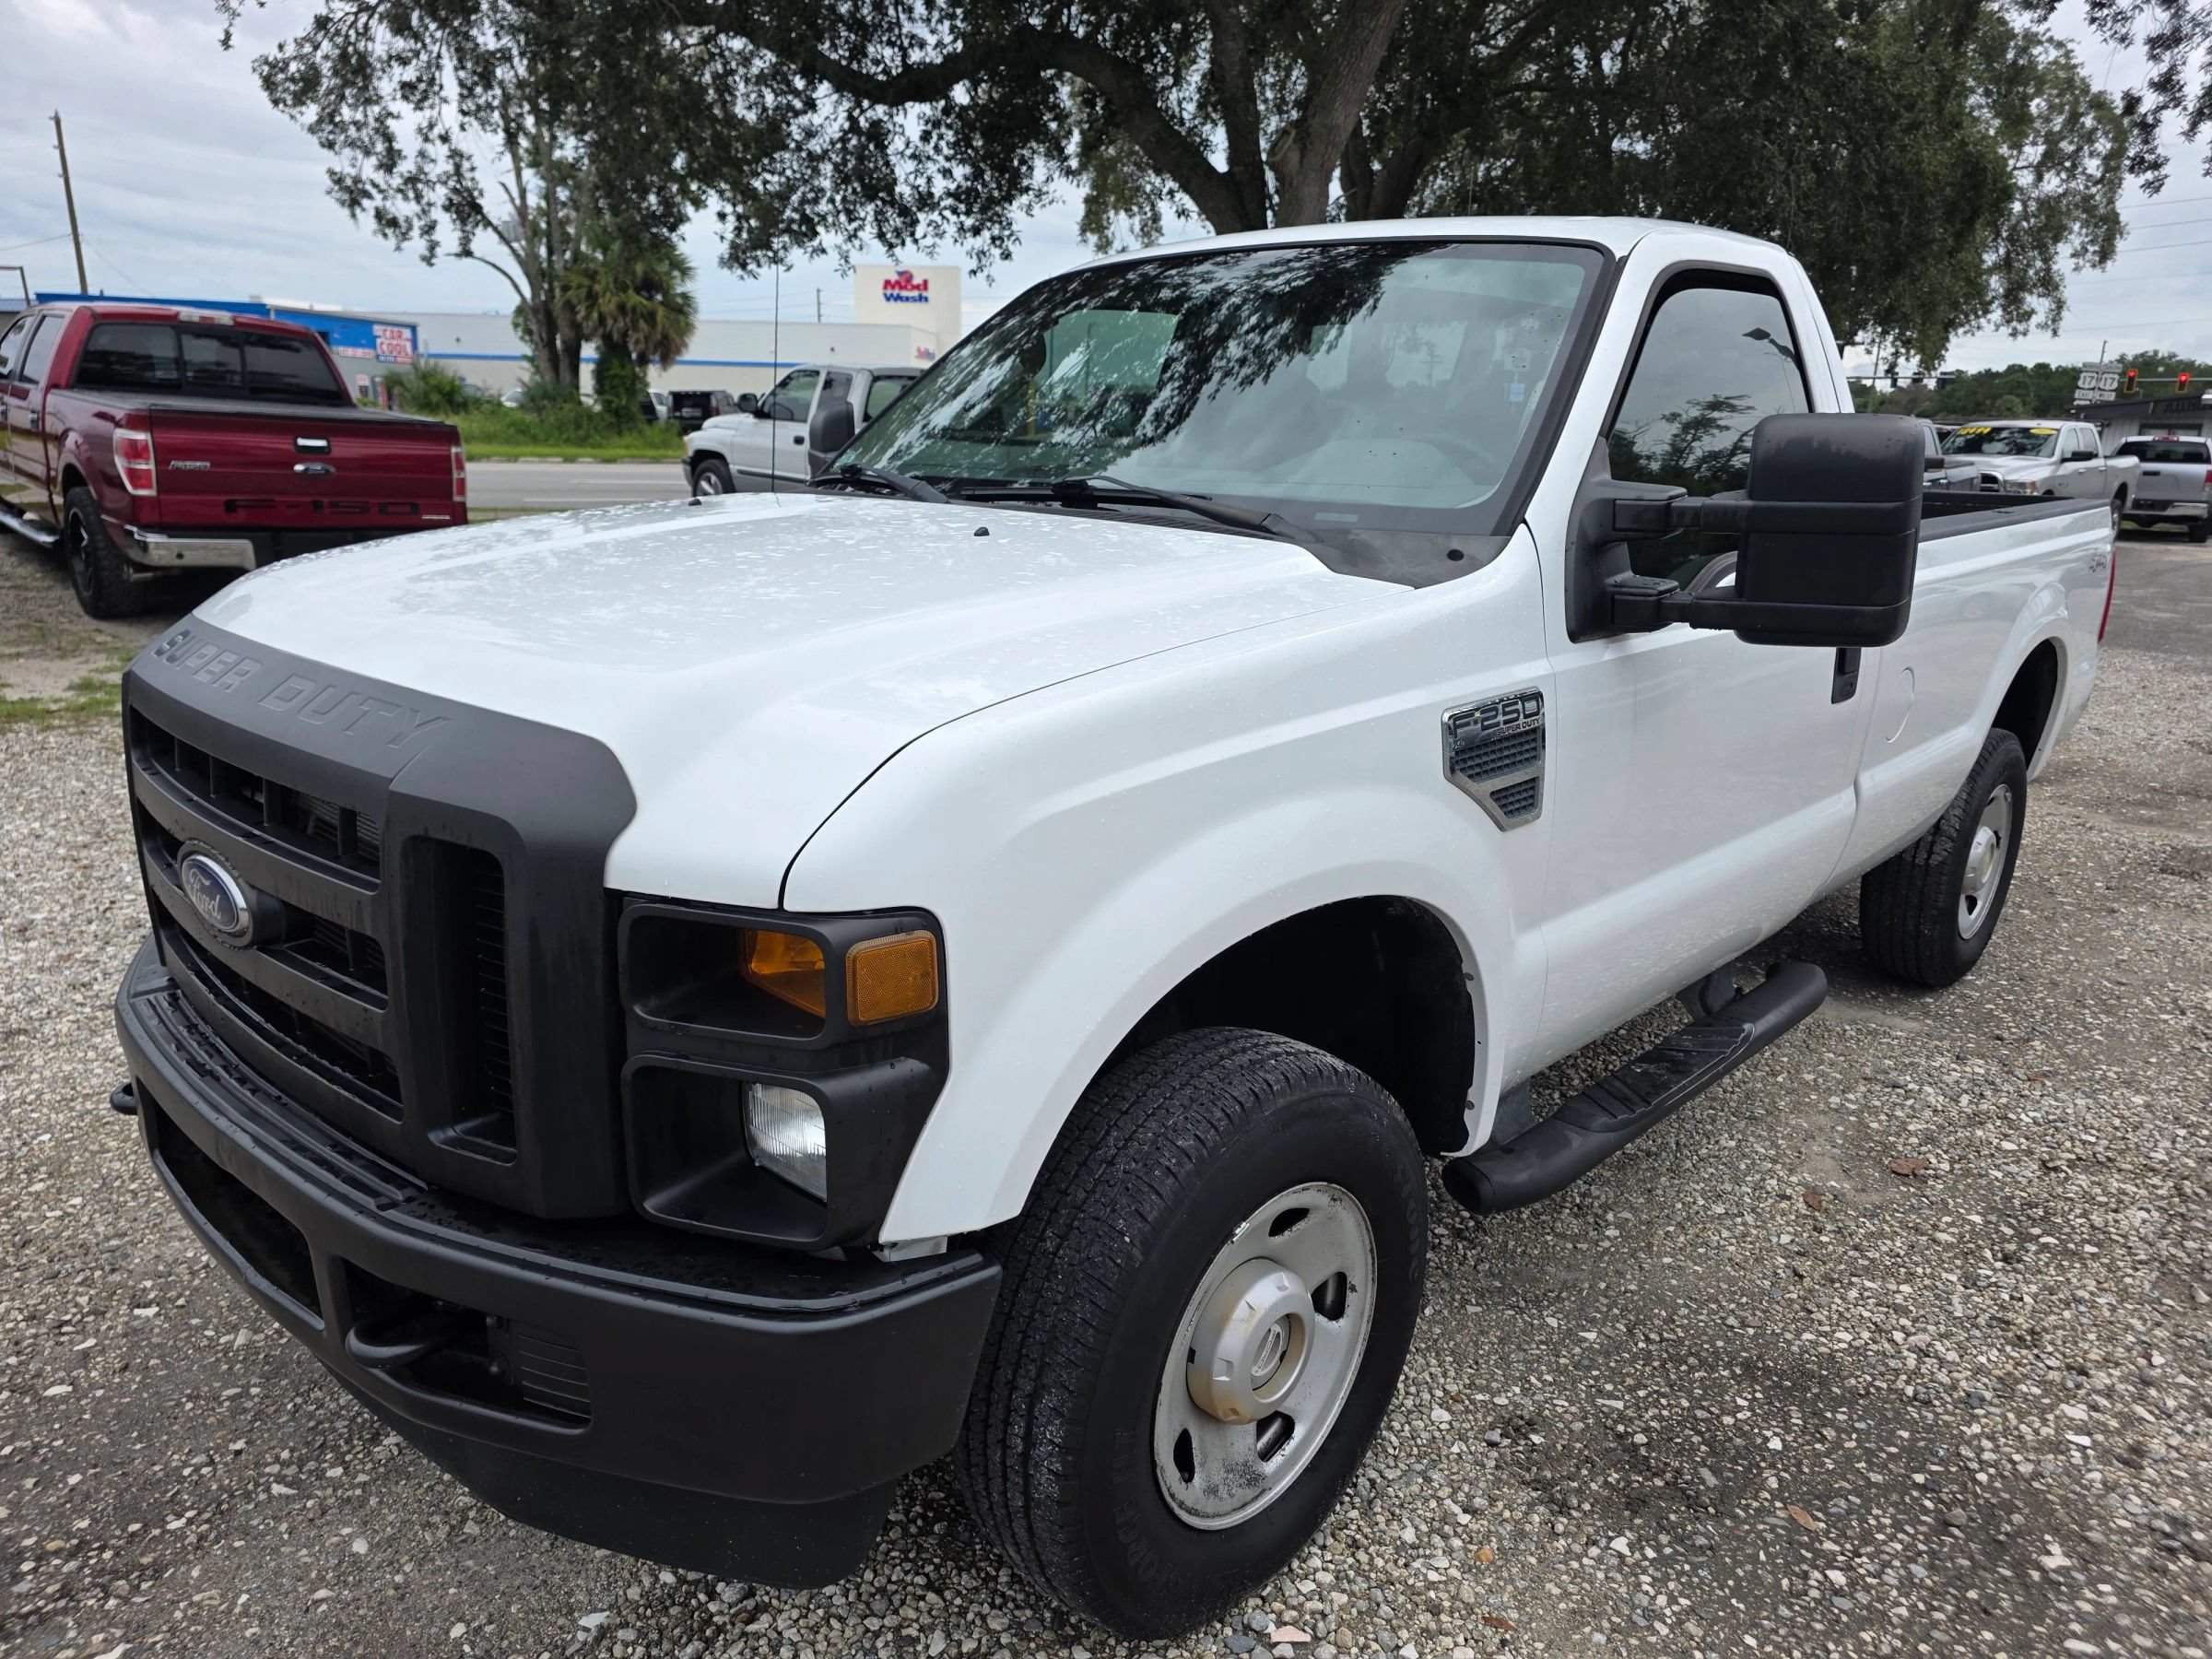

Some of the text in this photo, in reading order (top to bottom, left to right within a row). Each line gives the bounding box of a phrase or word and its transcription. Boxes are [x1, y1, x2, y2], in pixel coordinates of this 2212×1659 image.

[883, 279, 928, 291] Mod
[884, 292, 928, 302] Wash
[382, 328, 403, 338] CAR
[380, 341, 410, 356] COOL
[2082, 376, 2095, 386] 17
[2103, 377, 2116, 387] 17
[151, 629, 264, 693] SUPER
[257, 673, 454, 748] DUTY
[1497, 717, 1542, 736] SUPER DUTY
[188, 868, 222, 920] Ford
